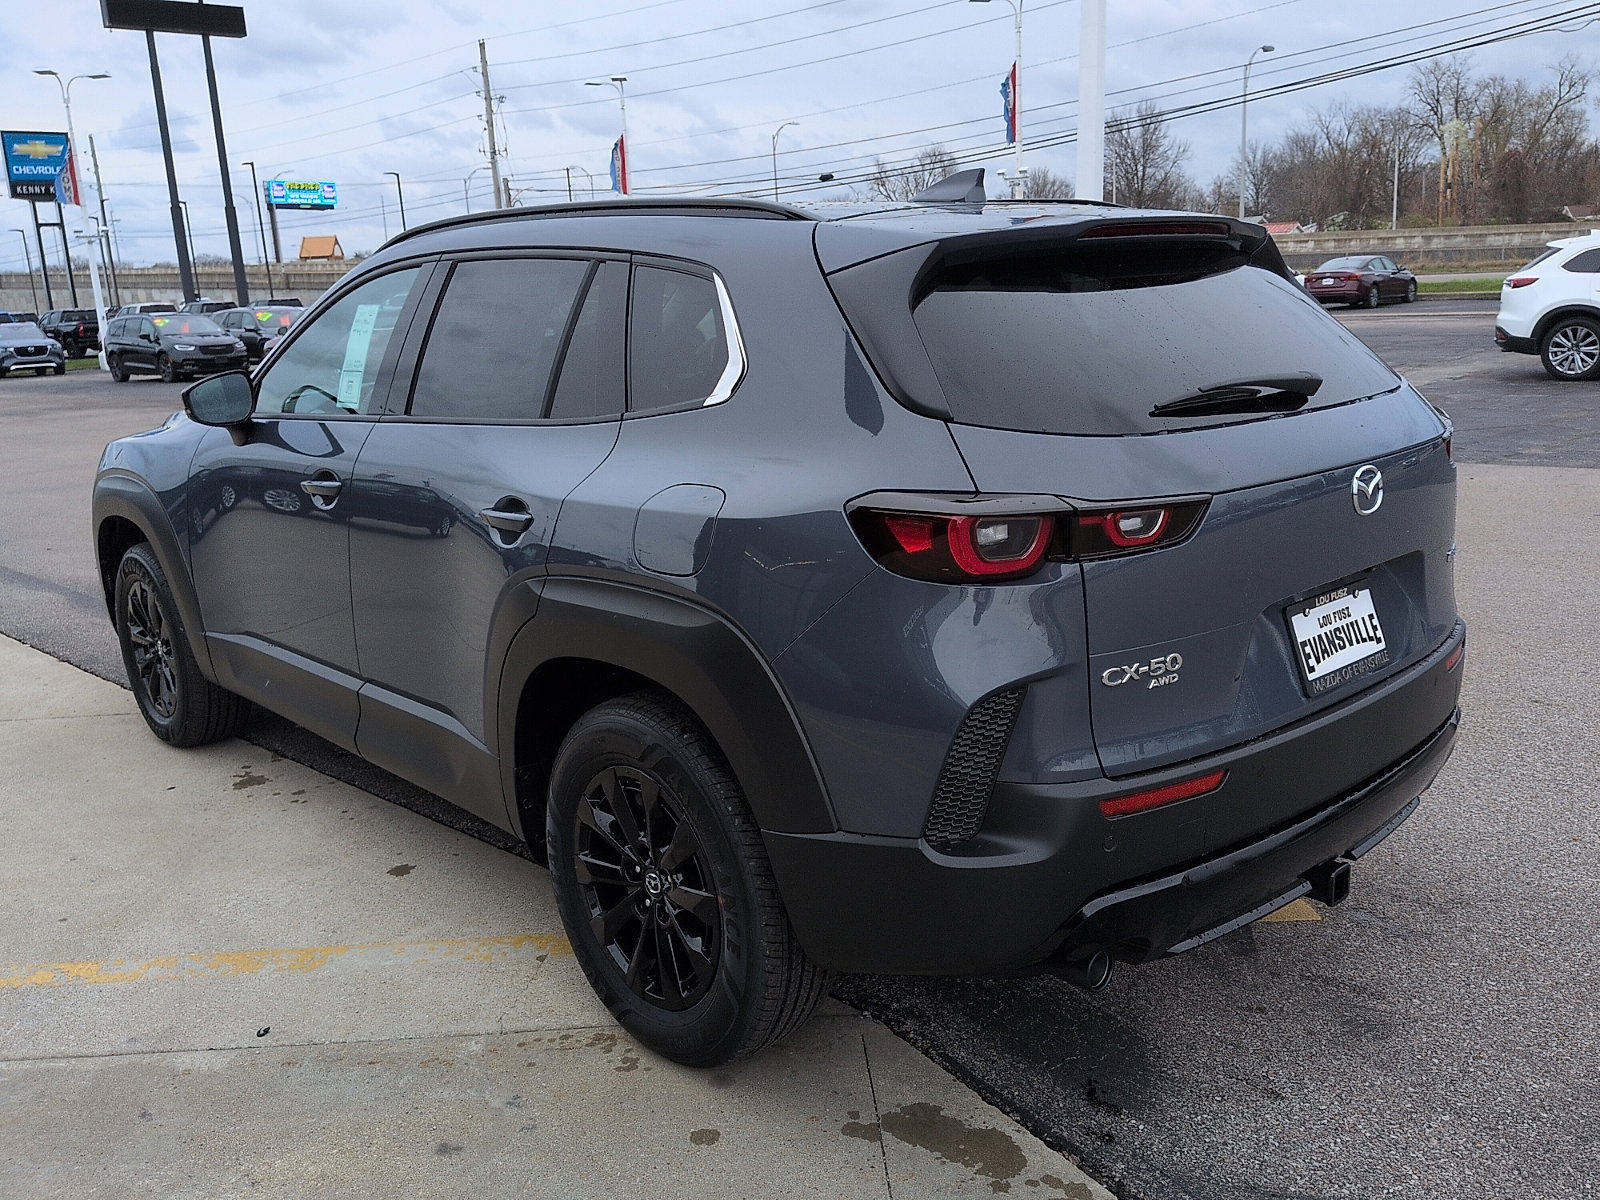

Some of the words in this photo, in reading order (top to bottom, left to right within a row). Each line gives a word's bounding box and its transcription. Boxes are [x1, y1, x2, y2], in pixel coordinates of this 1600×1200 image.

[13, 165, 62, 175] CHEVROLE
[16, 185, 46, 194] KENNY
[1315, 594, 1330, 606] LOU
[1331, 587, 1348, 601] FUSZ
[1317, 613, 1332, 628] LOU
[1333, 606, 1352, 622] FUSZ
[1299, 612, 1383, 675] EVANSVILLE
[1101, 652, 1183, 687] CX-50
[1312, 675, 1342, 693] MAZDA
[1342, 666, 1353, 680] OF
[1354, 650, 1390, 675] EVANSVILLE
[1148, 673, 1179, 689] AWD
